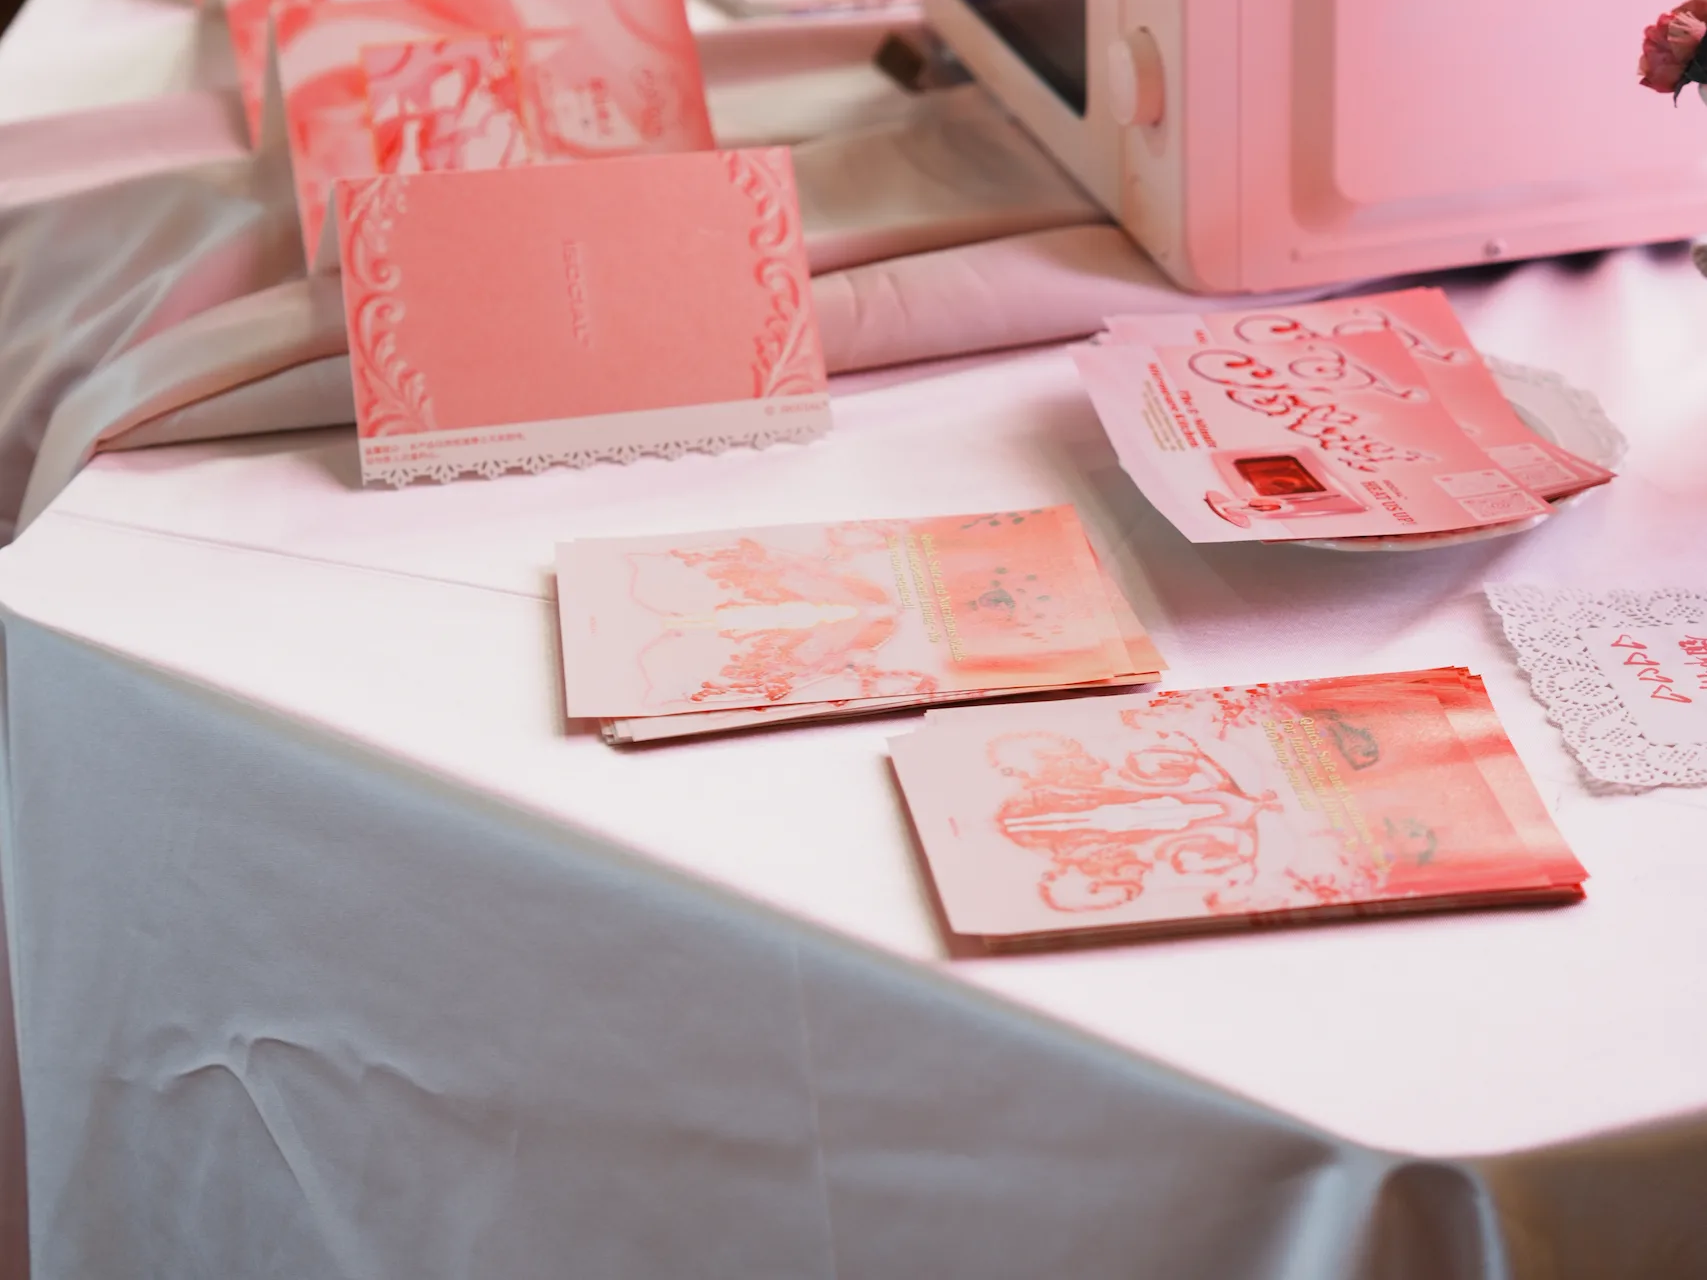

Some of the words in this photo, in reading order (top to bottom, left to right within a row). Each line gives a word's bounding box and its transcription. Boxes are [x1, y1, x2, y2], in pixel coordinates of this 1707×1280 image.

[1175, 413, 1199, 448] Kitchen
[1360, 481, 1391, 500] HEAT
[1381, 501, 1402, 511] US
[1393, 511, 1418, 525] UP!
[920, 600, 936, 625] Living
[938, 595, 957, 638] Nutritious
[1317, 750, 1337, 774] Safe
